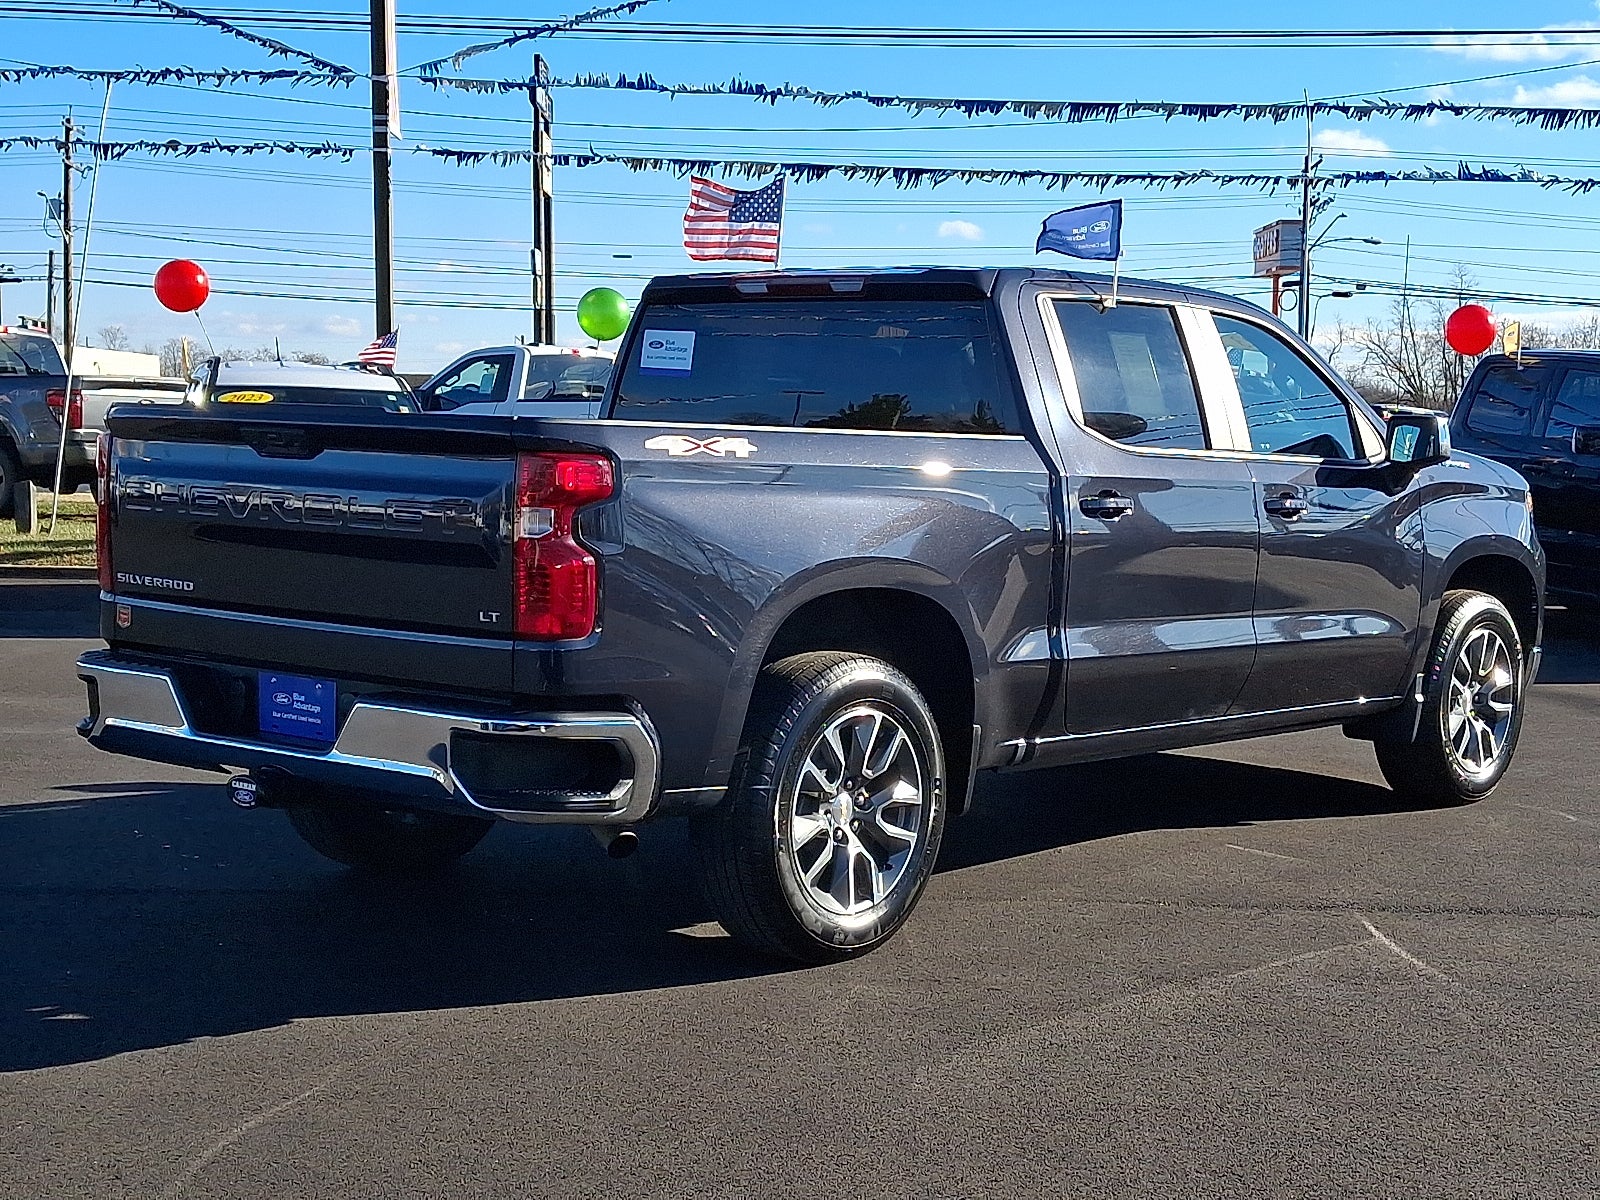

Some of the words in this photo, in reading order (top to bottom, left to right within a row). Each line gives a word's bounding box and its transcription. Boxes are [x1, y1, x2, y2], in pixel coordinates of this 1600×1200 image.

[231, 393, 264, 402] 2023
[123, 479, 473, 534] CHEVROLET
[117, 572, 195, 591] SILVERADO
[480, 611, 500, 623] LT
[293, 692, 305, 702] Blue
